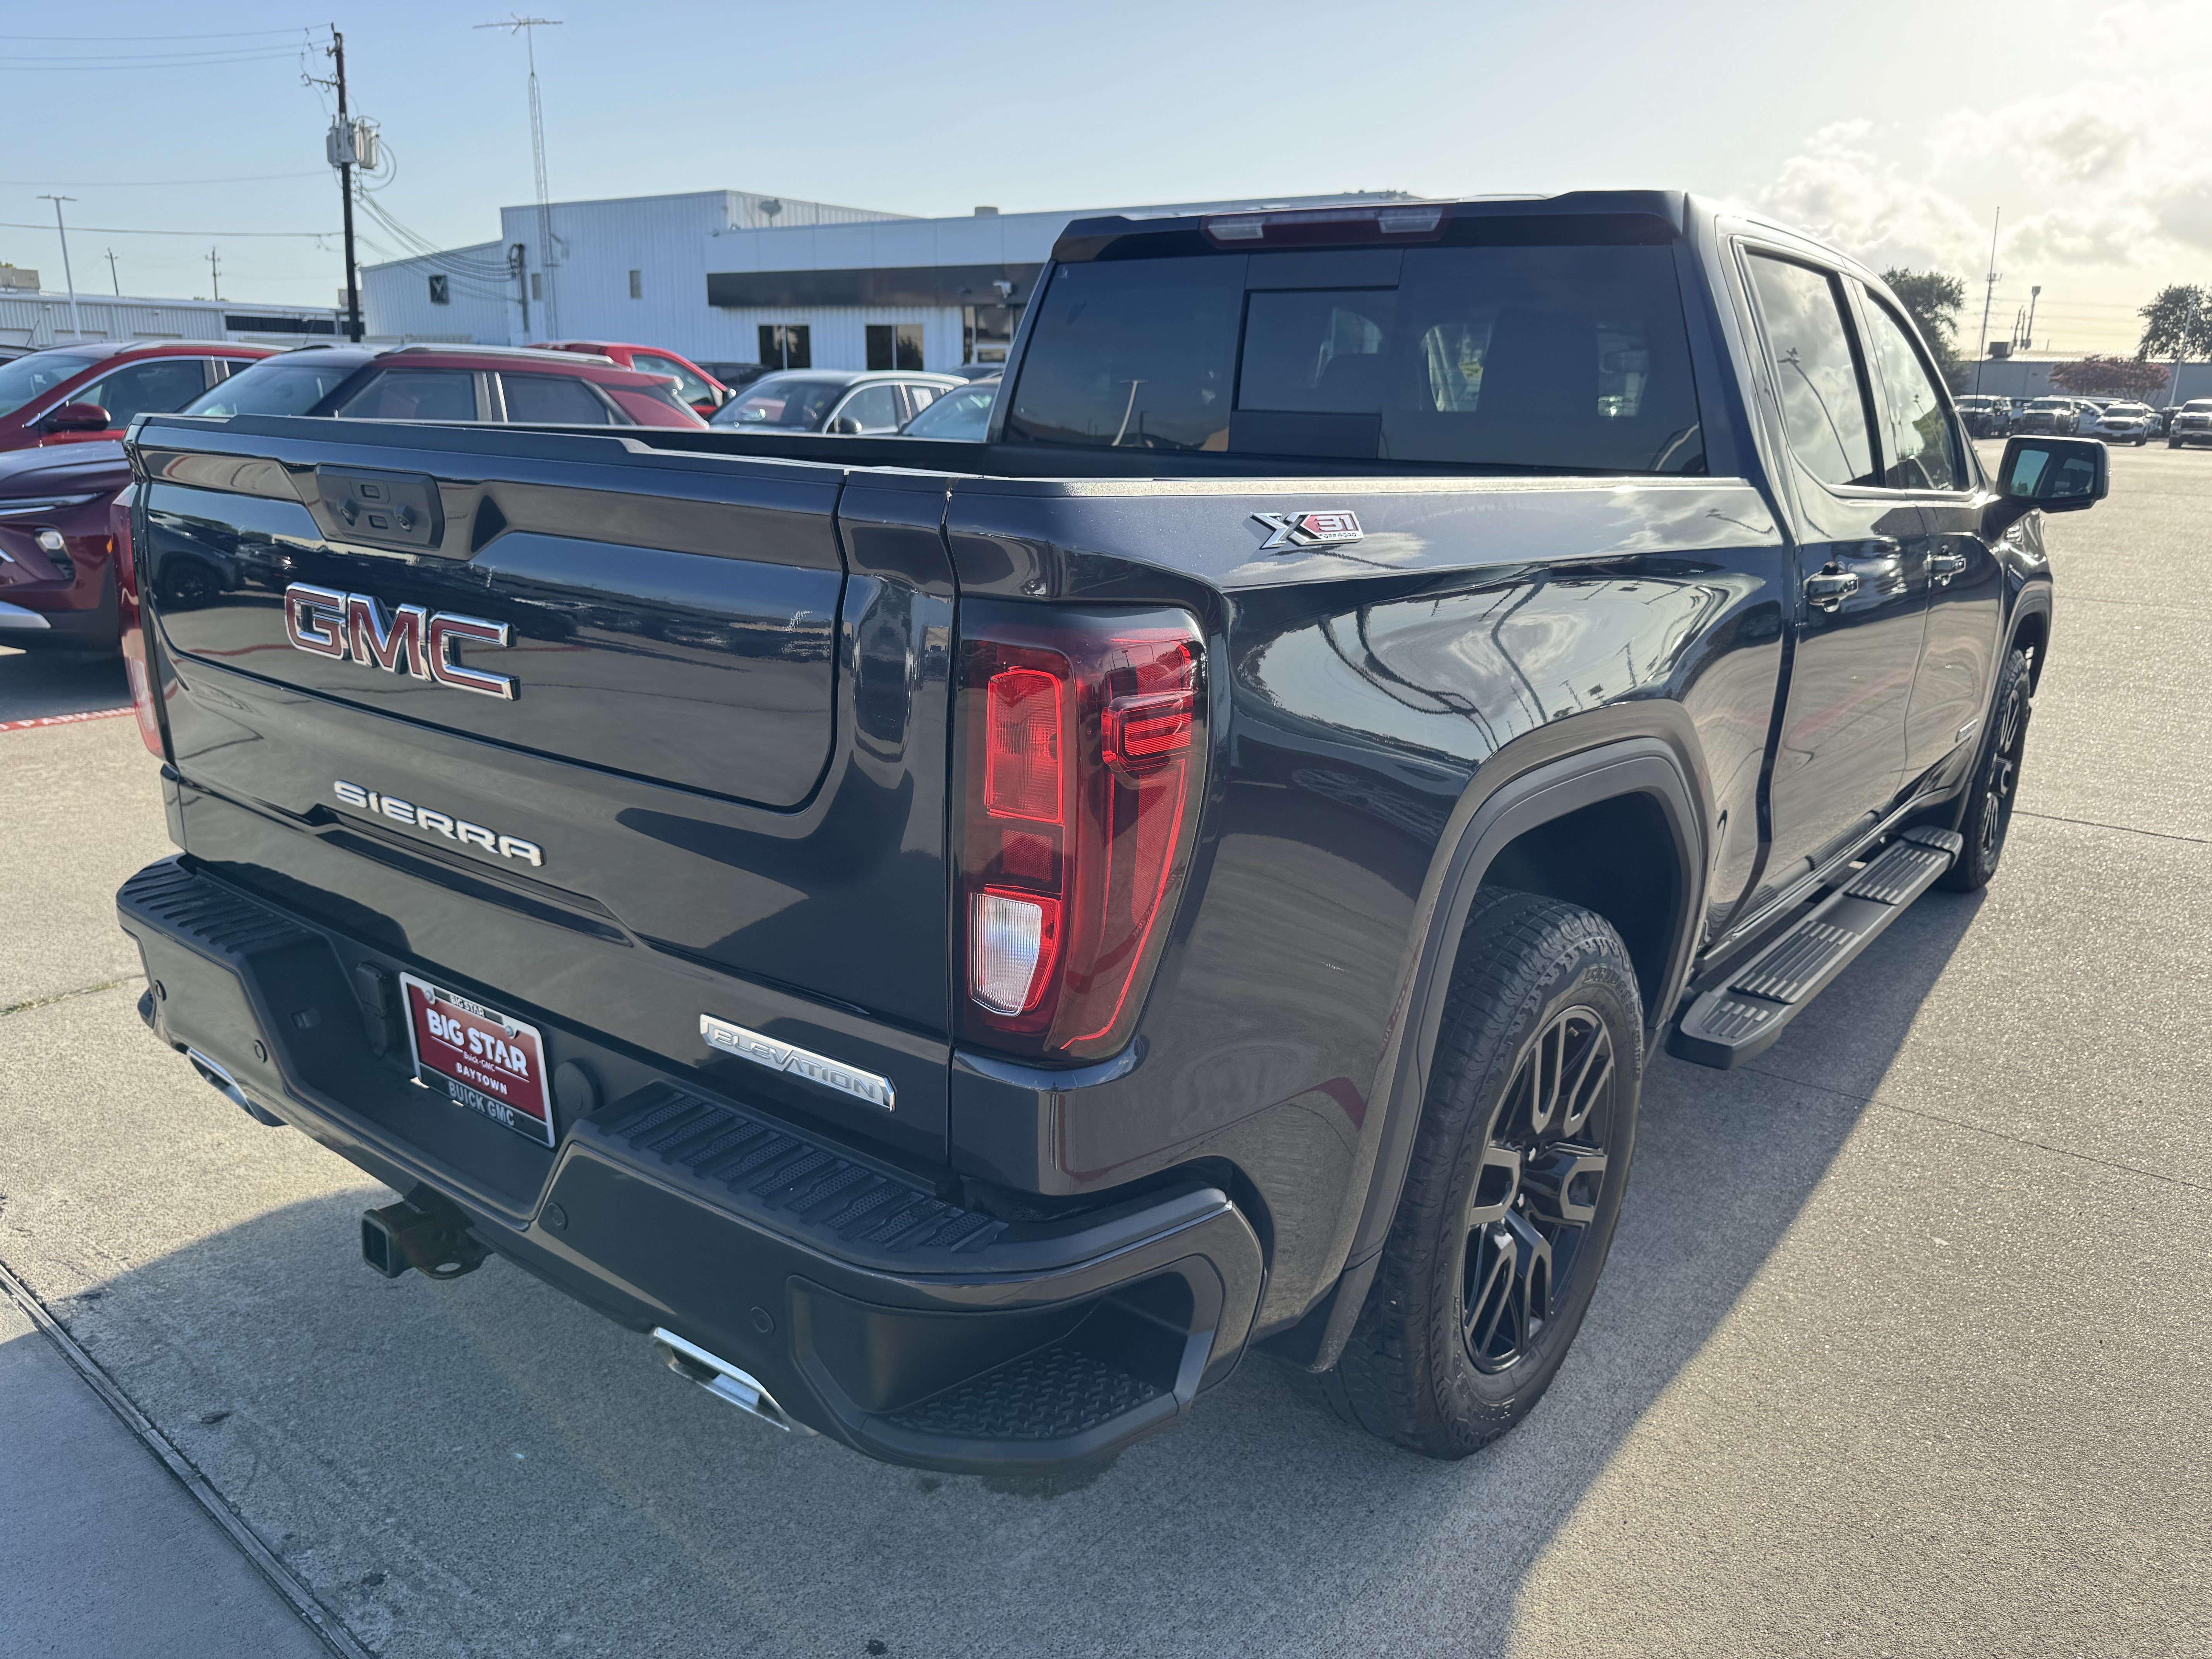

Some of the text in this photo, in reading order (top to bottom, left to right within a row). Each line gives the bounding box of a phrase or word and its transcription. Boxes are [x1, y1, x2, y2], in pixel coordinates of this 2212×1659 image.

[285, 582, 520, 701] GMC
[334, 779, 544, 866] SIERRA
[450, 995, 485, 1017] BIG STAR
[426, 1008, 529, 1077] BIG STAR
[714, 1028, 876, 1099] ELEVATION
[448, 1080, 515, 1126] BUICK GMC
[455, 1061, 508, 1096] BAYTOWN
